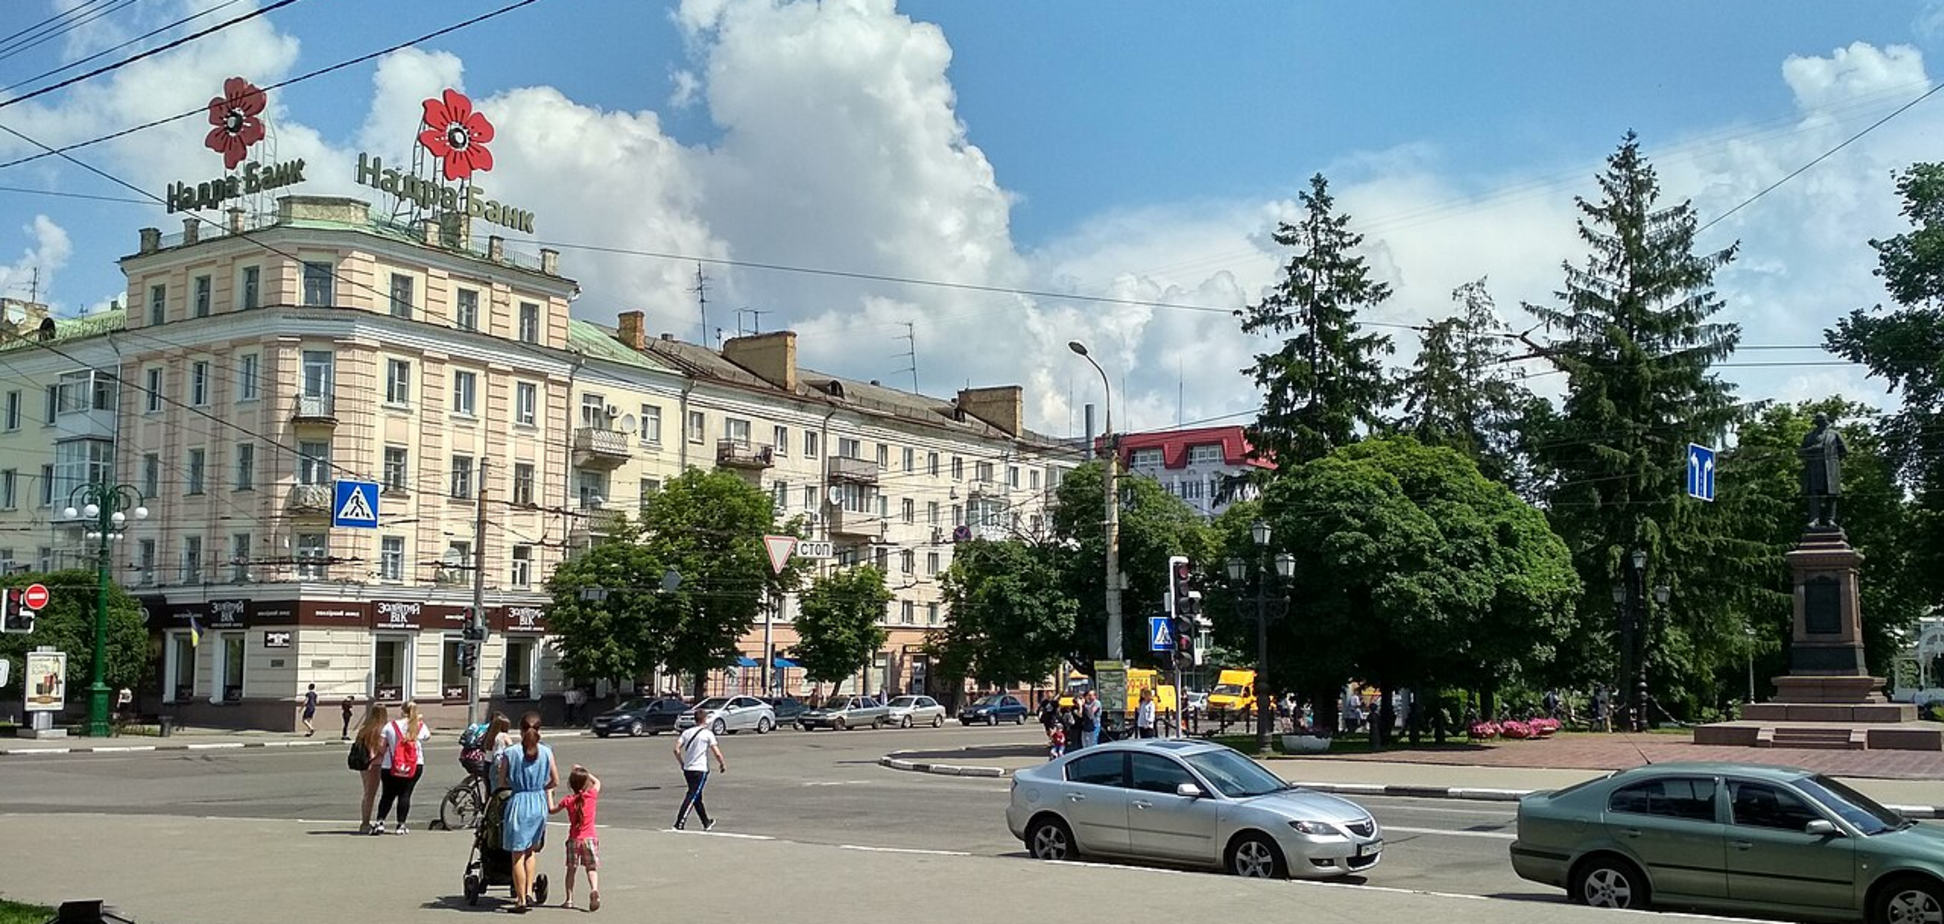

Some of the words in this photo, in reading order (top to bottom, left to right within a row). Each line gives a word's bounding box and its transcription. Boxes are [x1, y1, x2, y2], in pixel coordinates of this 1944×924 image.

[167, 175, 241, 214] Надра
[243, 158, 306, 195] Банк
[357, 152, 458, 210] Надра
[466, 185, 535, 234] Банк
[800, 543, 830, 556] СТОП
